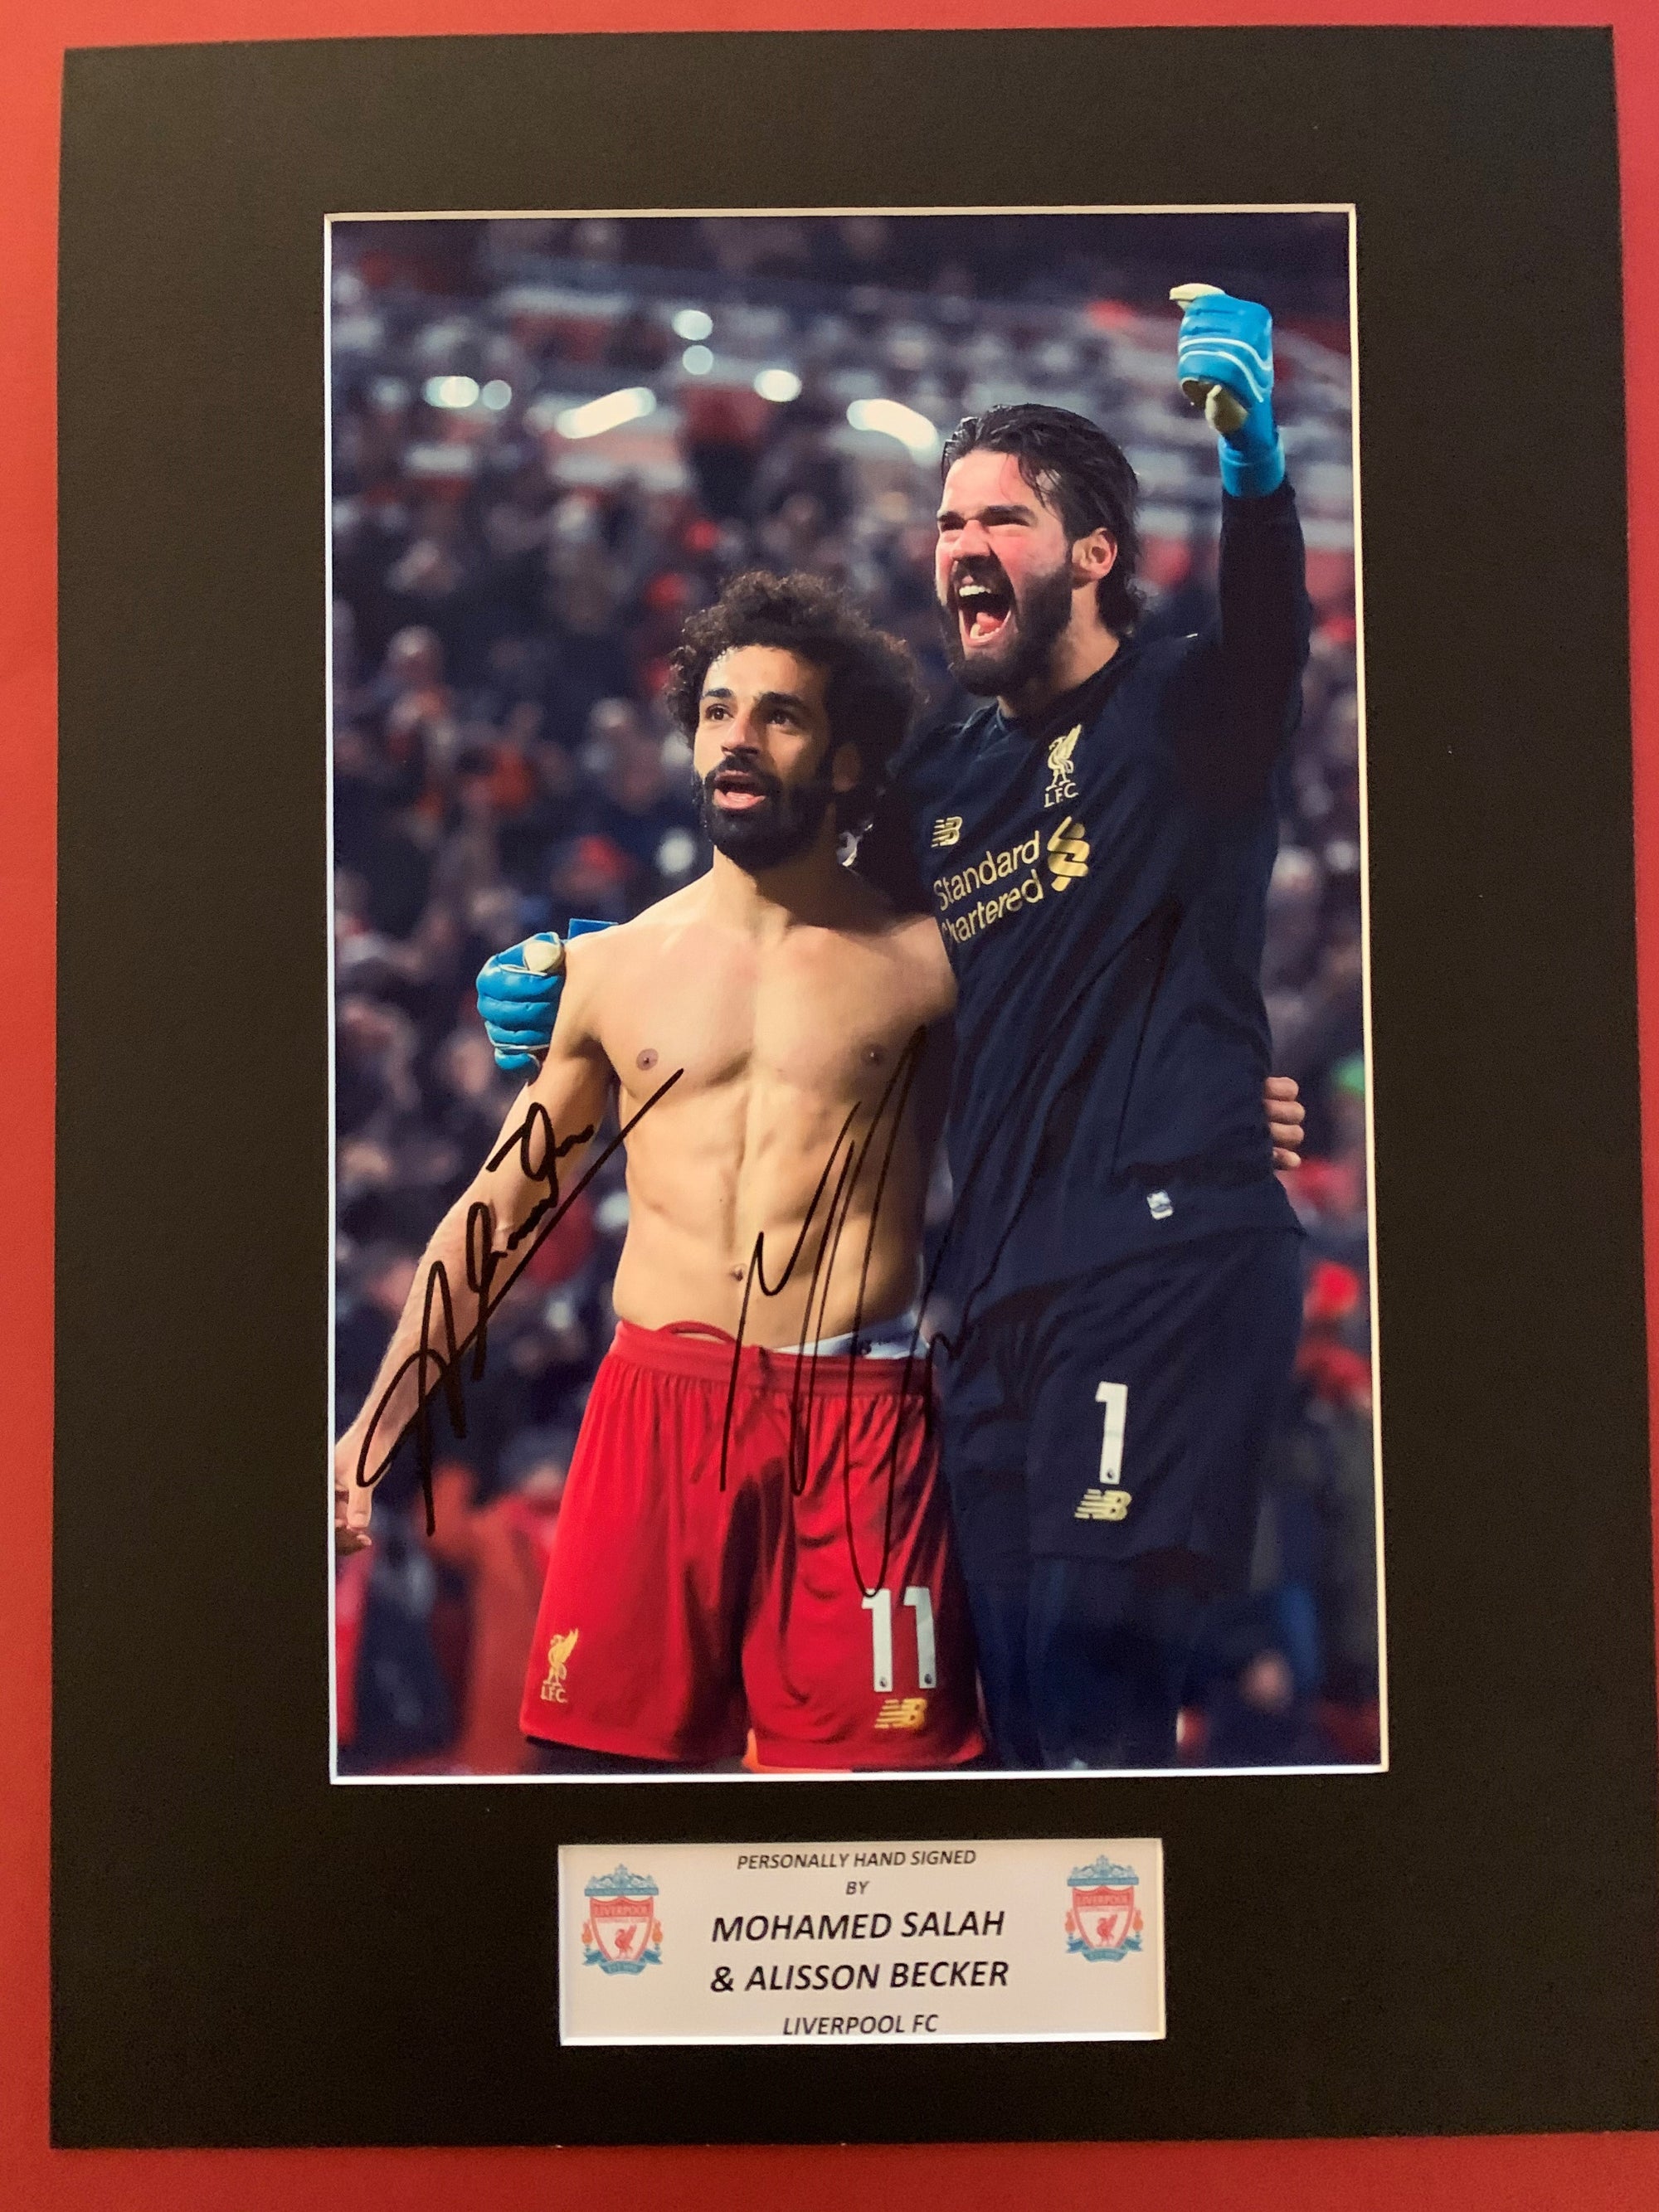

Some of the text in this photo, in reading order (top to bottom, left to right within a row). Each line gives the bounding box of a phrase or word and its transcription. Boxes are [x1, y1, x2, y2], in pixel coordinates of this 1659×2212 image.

[933, 830, 1040, 911] Standard
[1095, 1381, 1128, 1485] 1
[862, 1586, 937, 1692] 11
[737, 1850, 976, 1869] PERSONALLY HAND SIGNED
[845, 1881, 869, 1895] BY
[712, 1911, 1005, 1942] MOHAMED SALAH
[710, 1962, 1009, 1992] & ALISSON BECKER
[782, 2014, 939, 2035] LIVERPOOL FC
